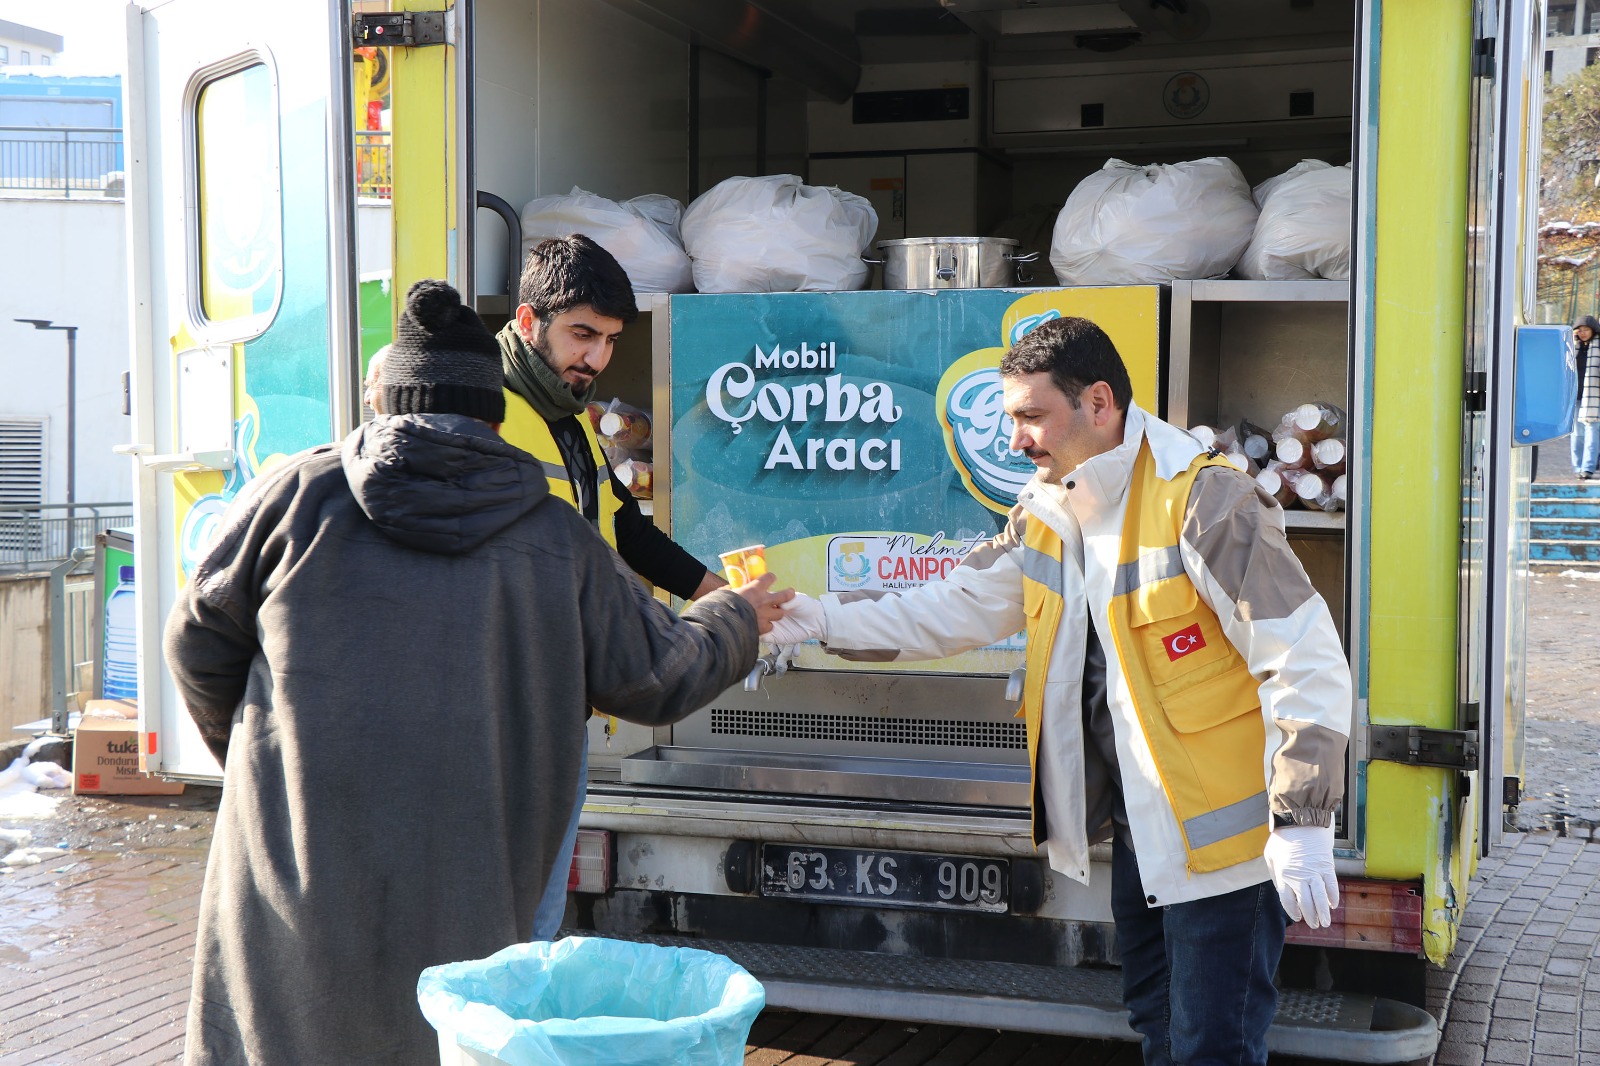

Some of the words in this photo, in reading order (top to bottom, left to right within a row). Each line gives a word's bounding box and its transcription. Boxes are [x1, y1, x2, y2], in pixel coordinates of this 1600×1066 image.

[755, 342, 835, 368] Mobil
[706, 362, 902, 434] Çorba
[764, 425, 900, 470] Aracı
[887, 532, 983, 555] Mehmet
[877, 556, 960, 580] CANPO
[786, 851, 829, 890] 63
[855, 855, 898, 895] KS
[937, 861, 1002, 904] 909
